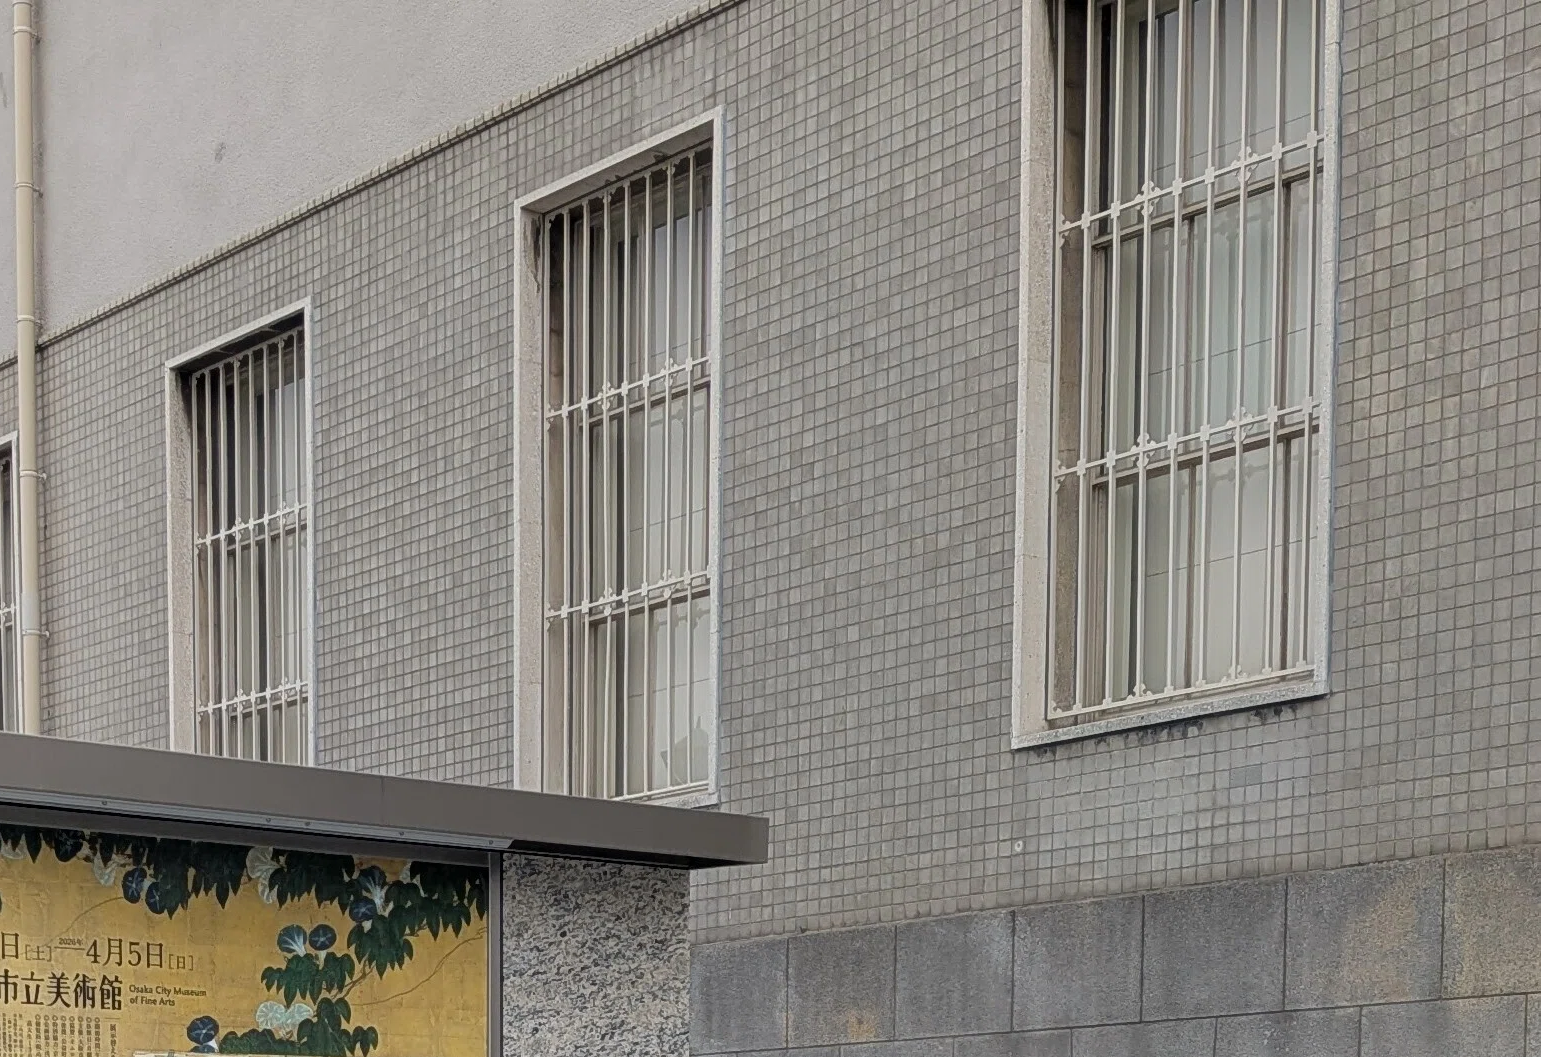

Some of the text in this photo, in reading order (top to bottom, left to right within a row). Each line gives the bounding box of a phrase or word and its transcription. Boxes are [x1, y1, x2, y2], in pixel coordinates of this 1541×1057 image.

[129, 985, 207, 998] Osaka City Museum
[129, 996, 175, 1007] of Fine Arts
